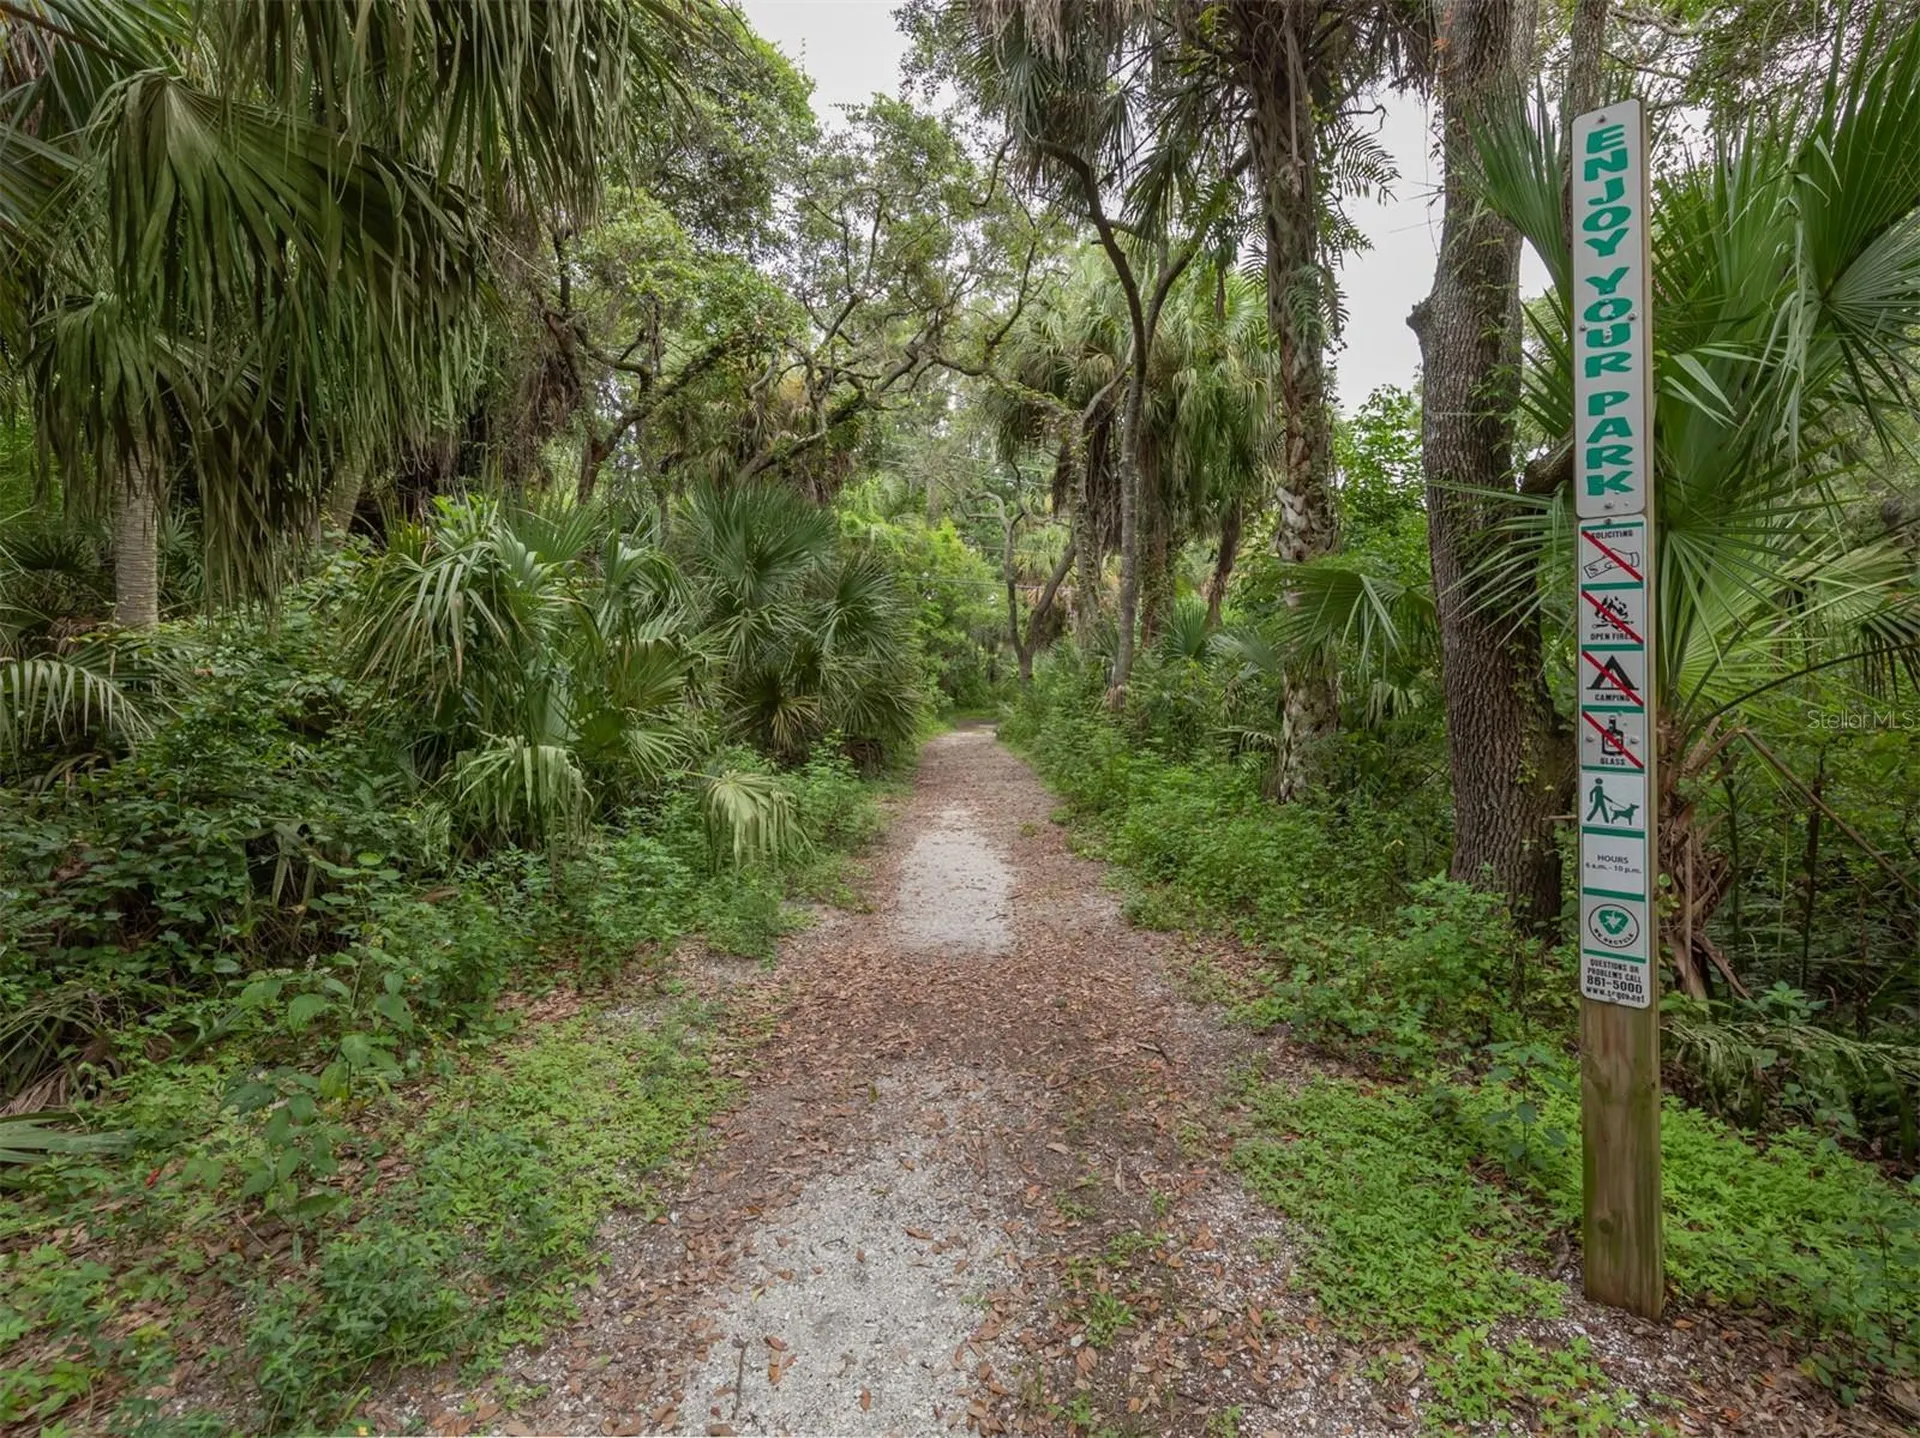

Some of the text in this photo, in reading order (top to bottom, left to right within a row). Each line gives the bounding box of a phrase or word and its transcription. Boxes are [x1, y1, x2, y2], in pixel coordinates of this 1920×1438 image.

[1582, 123, 1633, 496] ENJOY YOUR PARK
[1591, 529, 1634, 539] SOLICITING
[1600, 757, 1625, 765] GLASS
[1597, 855, 1629, 864] HOURS
[1590, 958, 1639, 973] QUESTIONS OR
[1587, 967, 1641, 983] PROBLEMS CALL
[1587, 975, 1643, 994] 861-5000
